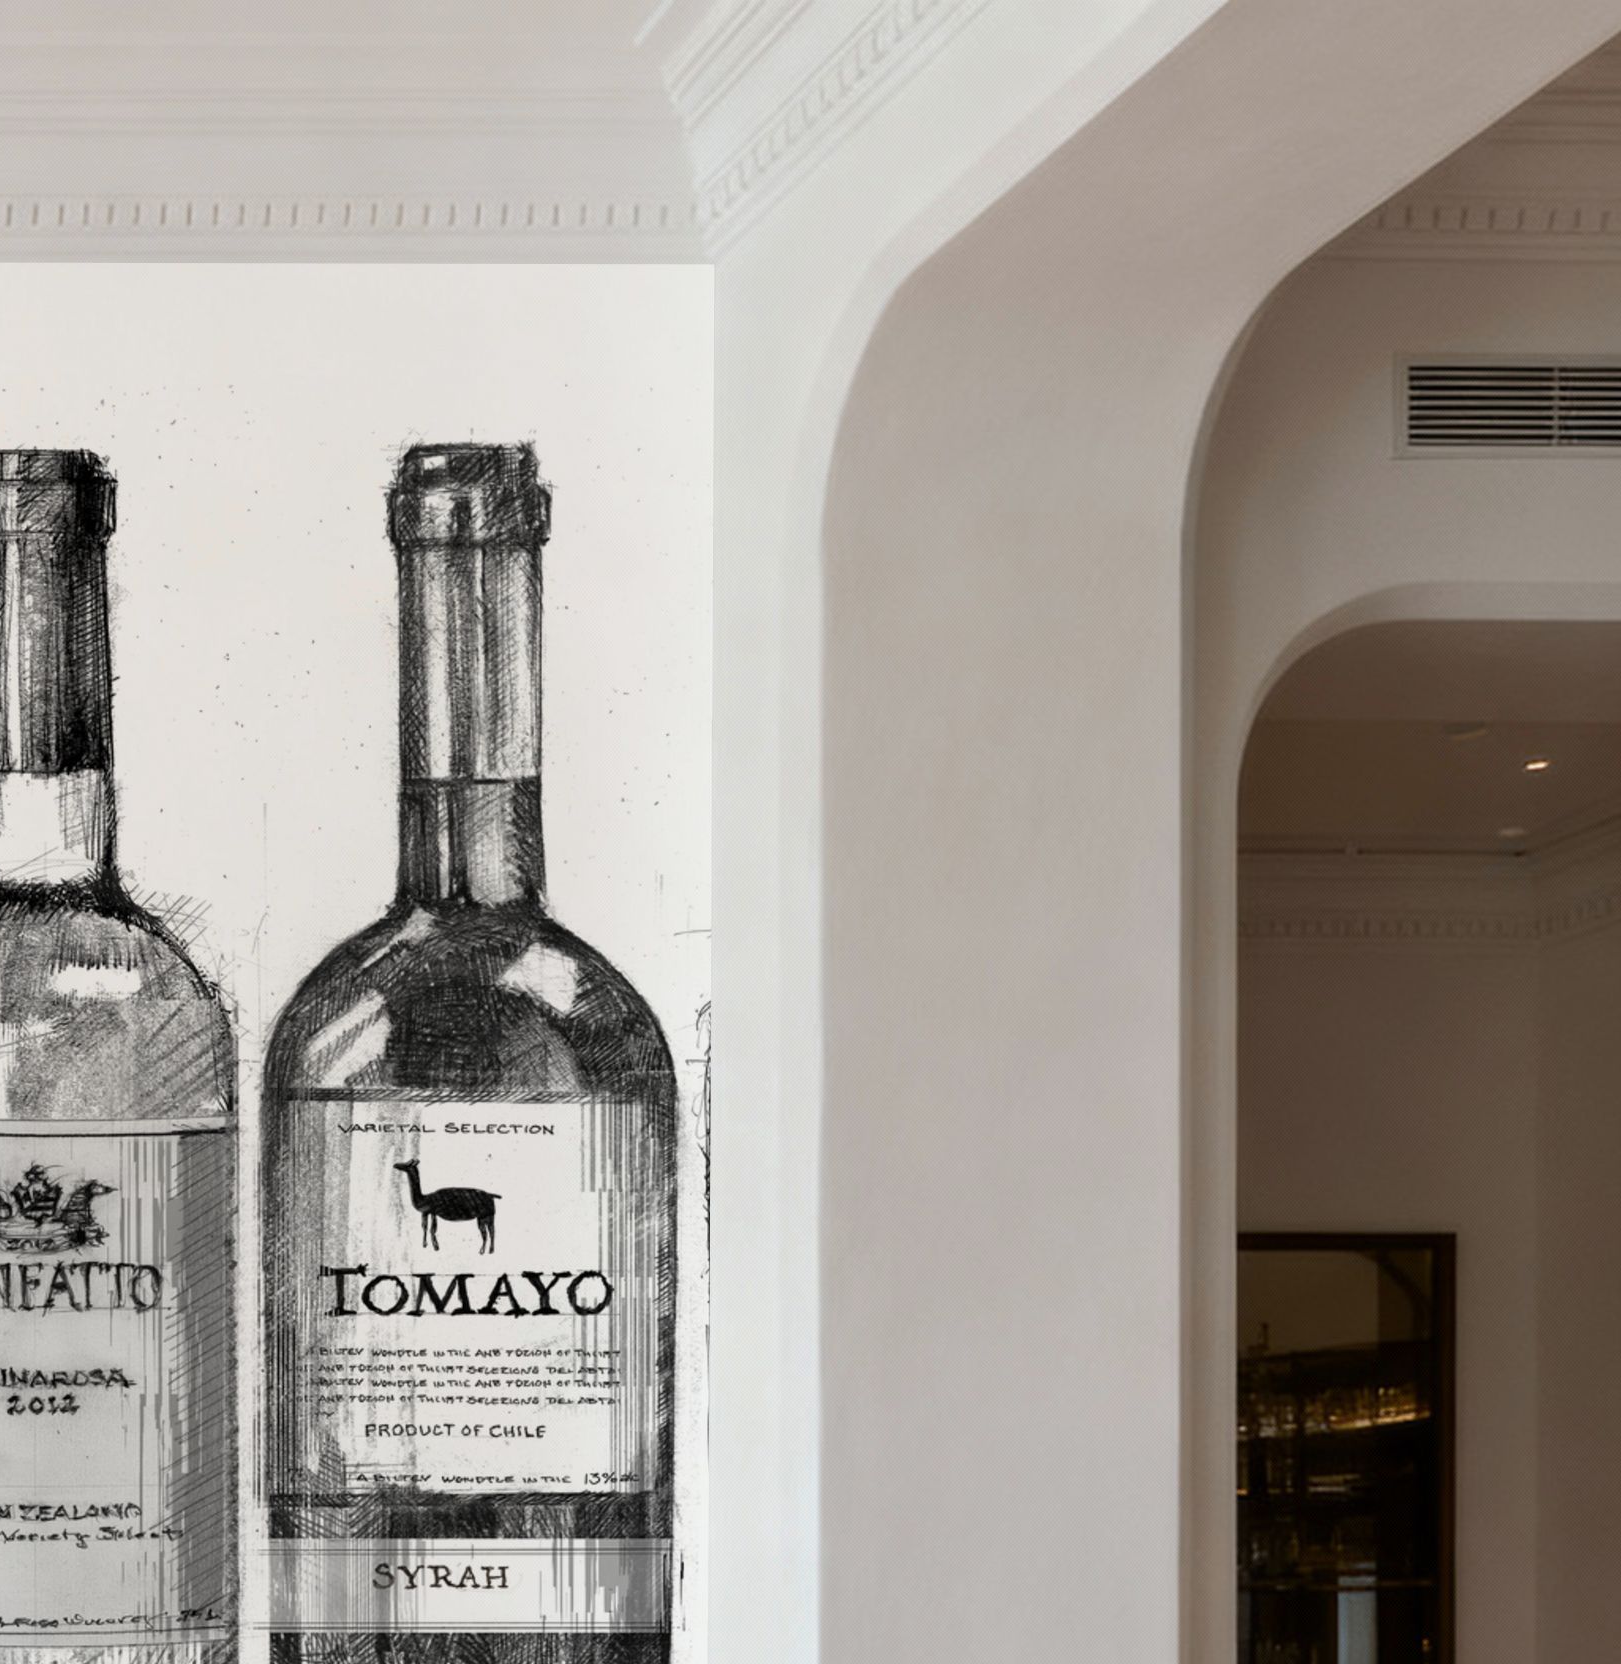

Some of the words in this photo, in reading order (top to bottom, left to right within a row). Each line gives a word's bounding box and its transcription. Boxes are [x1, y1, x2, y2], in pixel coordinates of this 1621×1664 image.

[338, 1122, 436, 1135] VARIETAL
[444, 1122, 555, 1135] SELECTION
[319, 1263, 615, 1318] TOMAYO
[6, 1394, 81, 1416] 2012
[365, 1423, 455, 1438] PRODUCT
[461, 1424, 485, 1438] OF
[489, 1424, 547, 1439] CHILE
[584, 1471, 617, 1485] 13%
[371, 1562, 510, 1590] SYRAH
